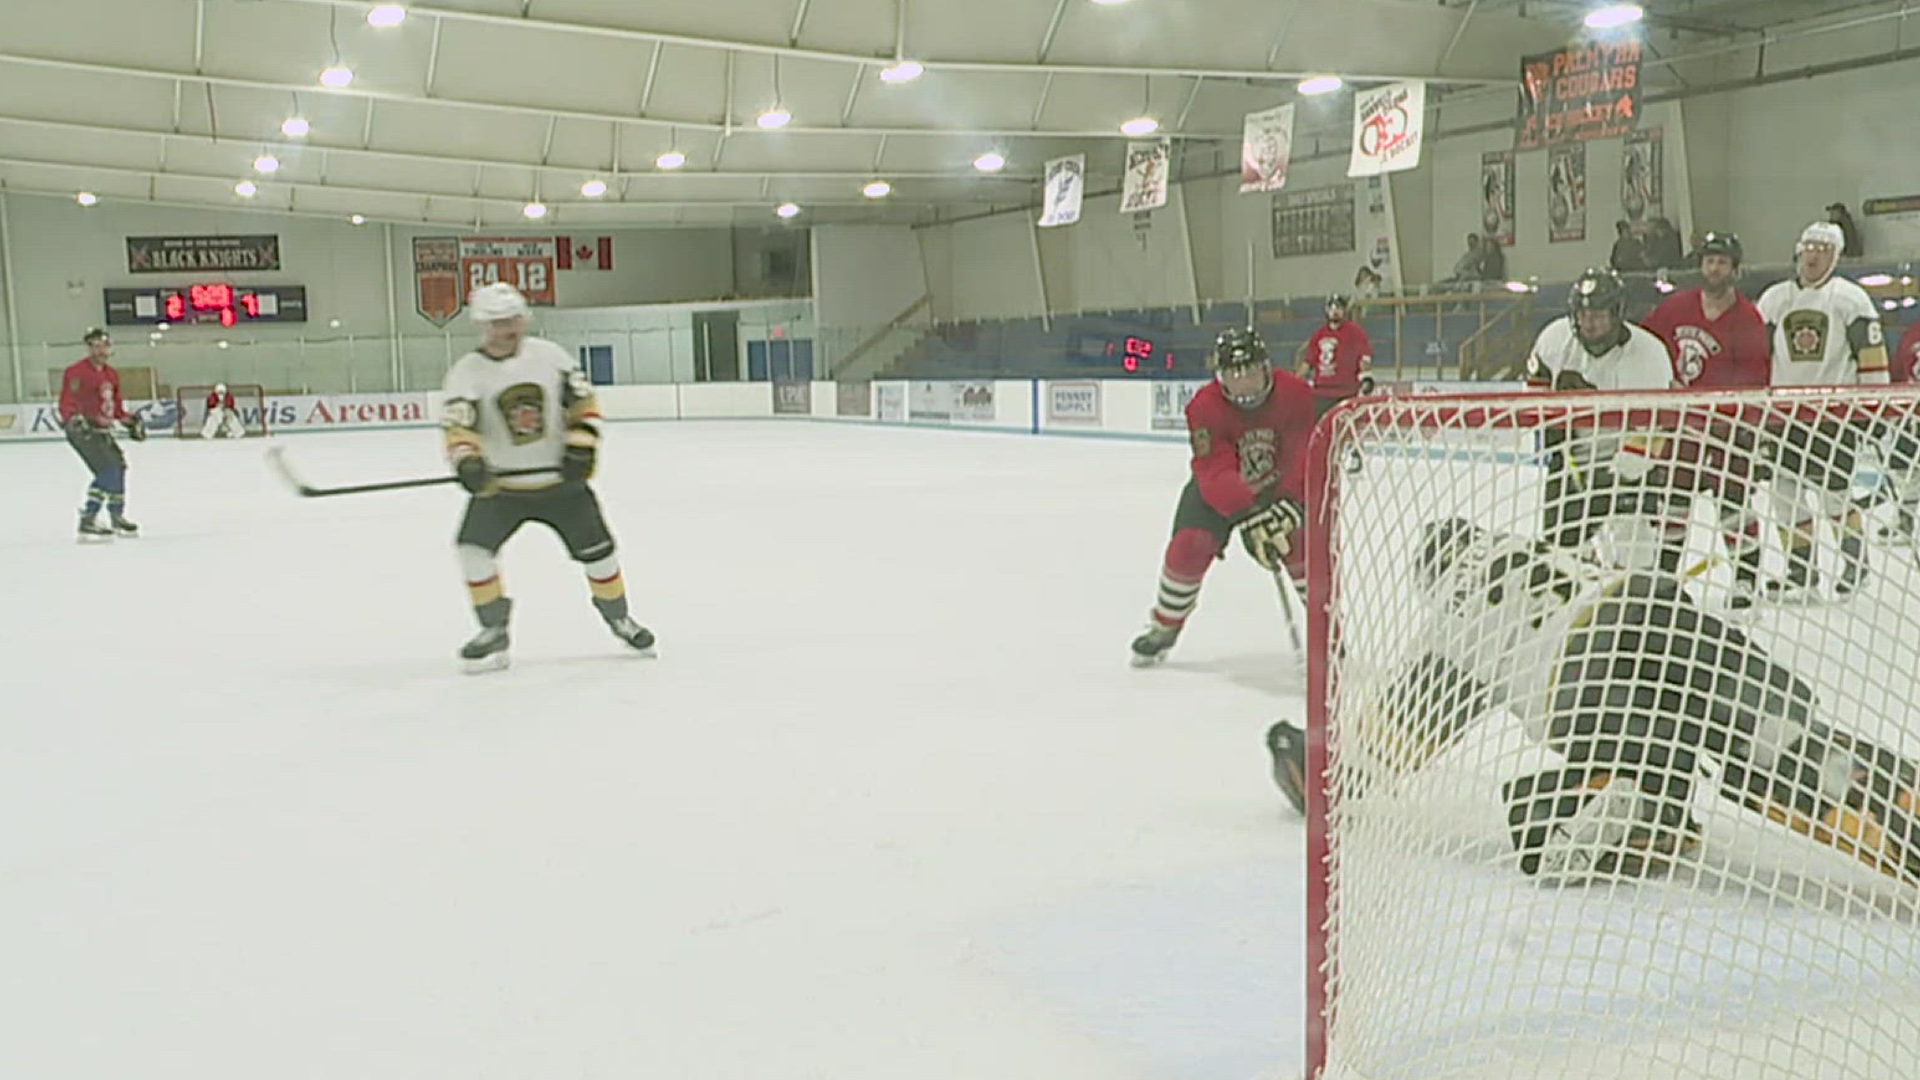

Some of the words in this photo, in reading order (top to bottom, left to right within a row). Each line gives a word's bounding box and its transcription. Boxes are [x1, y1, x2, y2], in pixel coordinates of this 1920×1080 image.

[1555, 65, 1637, 100] COUGARS
[151, 250, 197, 268] BLACK
[199, 248, 258, 268] KNIGHTS
[469, 262, 500, 290] 24
[516, 262, 547, 291] 12
[305, 399, 422, 424] Arena
